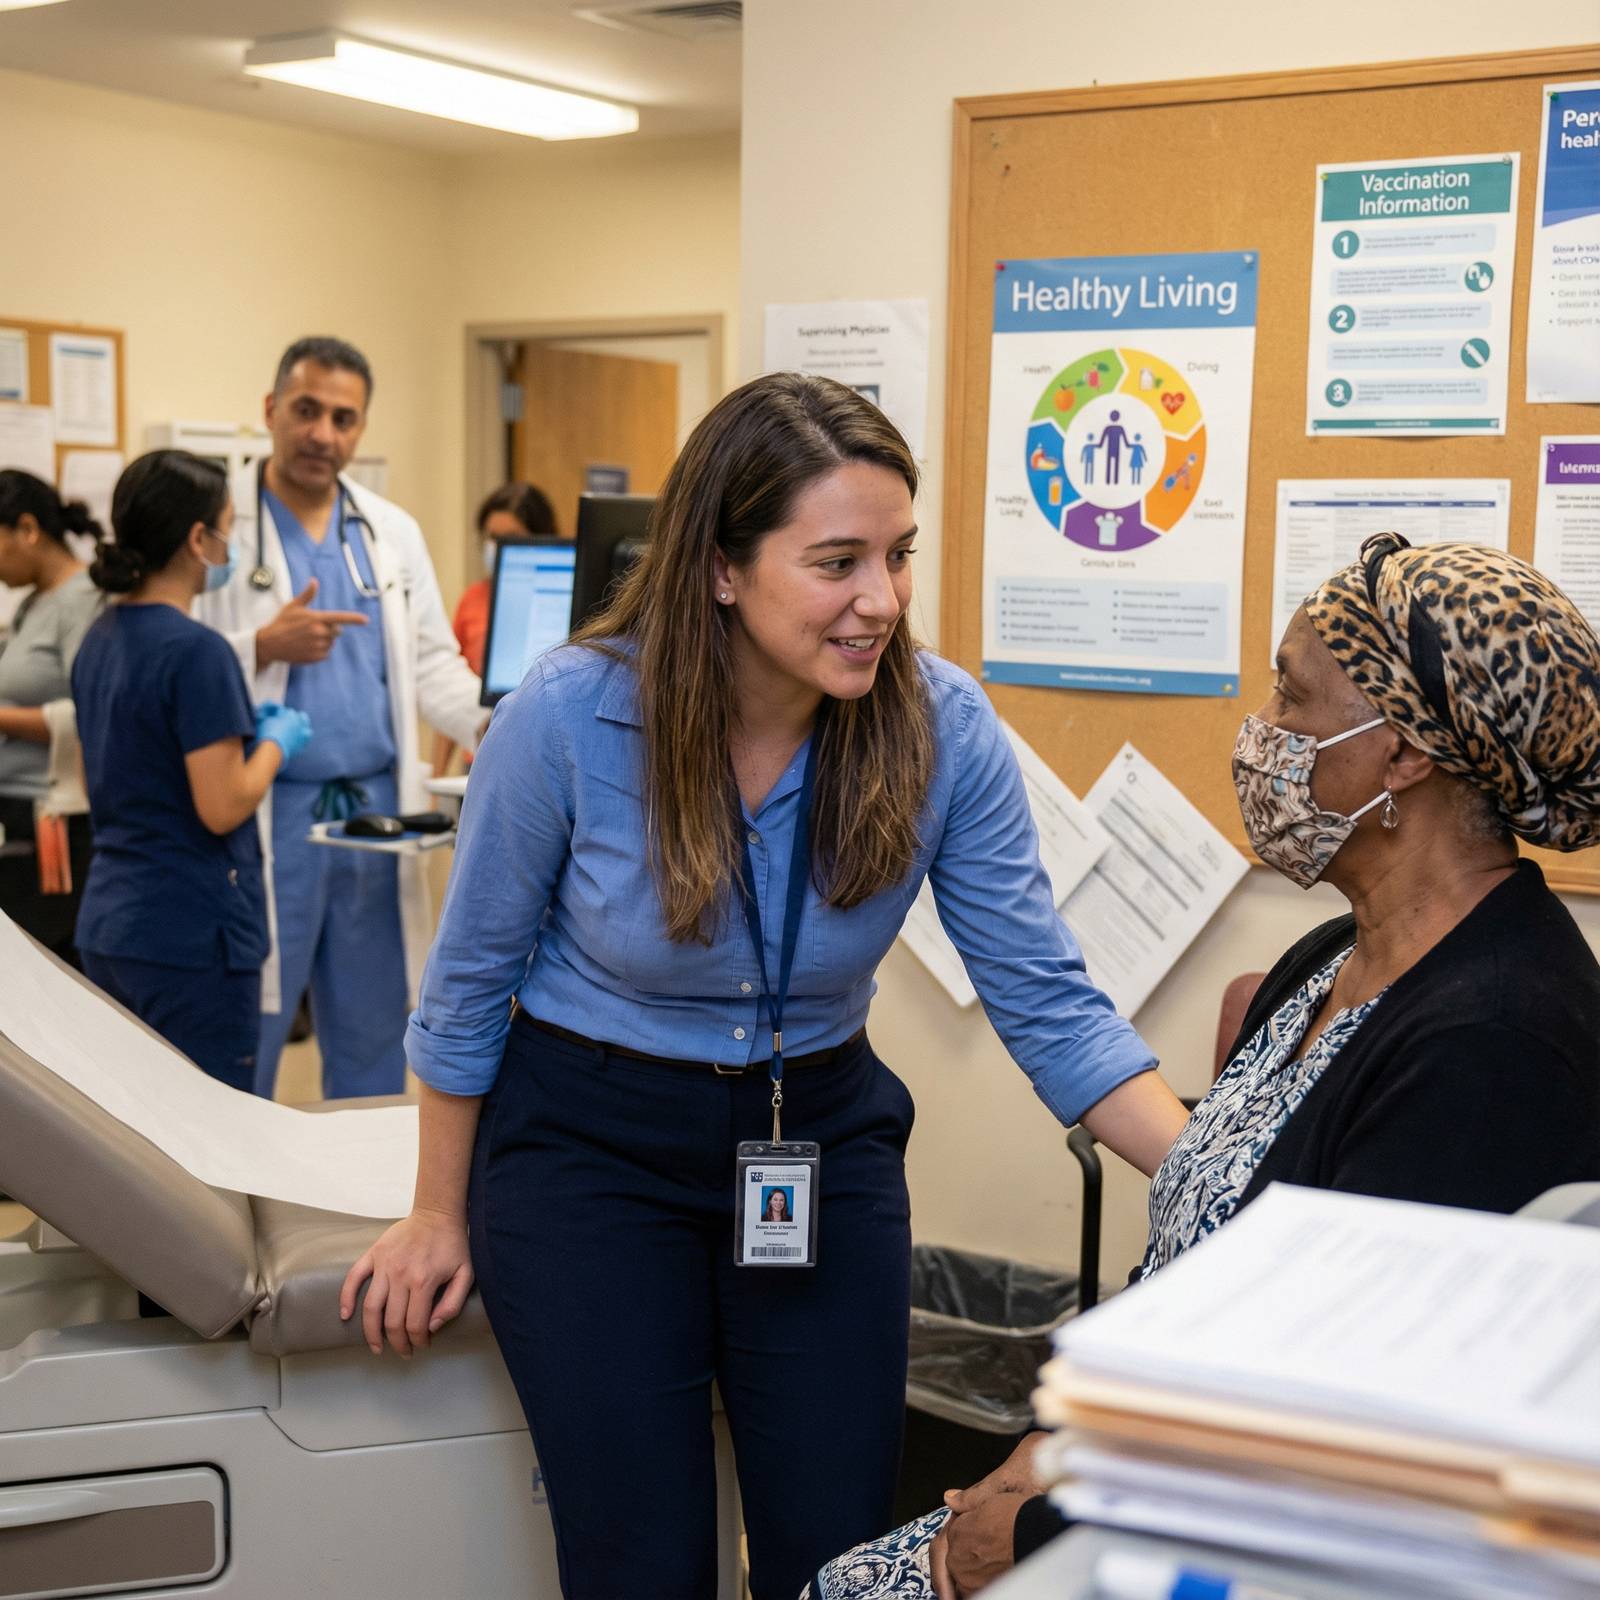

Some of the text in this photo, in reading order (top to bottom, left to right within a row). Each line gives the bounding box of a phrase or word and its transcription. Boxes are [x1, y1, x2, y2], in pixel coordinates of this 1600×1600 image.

[1562, 109, 1600, 128] Per
[1560, 130, 1600, 149] heal
[1361, 169, 1470, 193] Vaccination
[1359, 192, 1470, 216] Information
[1340, 235, 1350, 255] 1
[1012, 274, 1238, 318] Healthy Living
[1335, 310, 1349, 329] 2
[1331, 383, 1346, 402] 3
